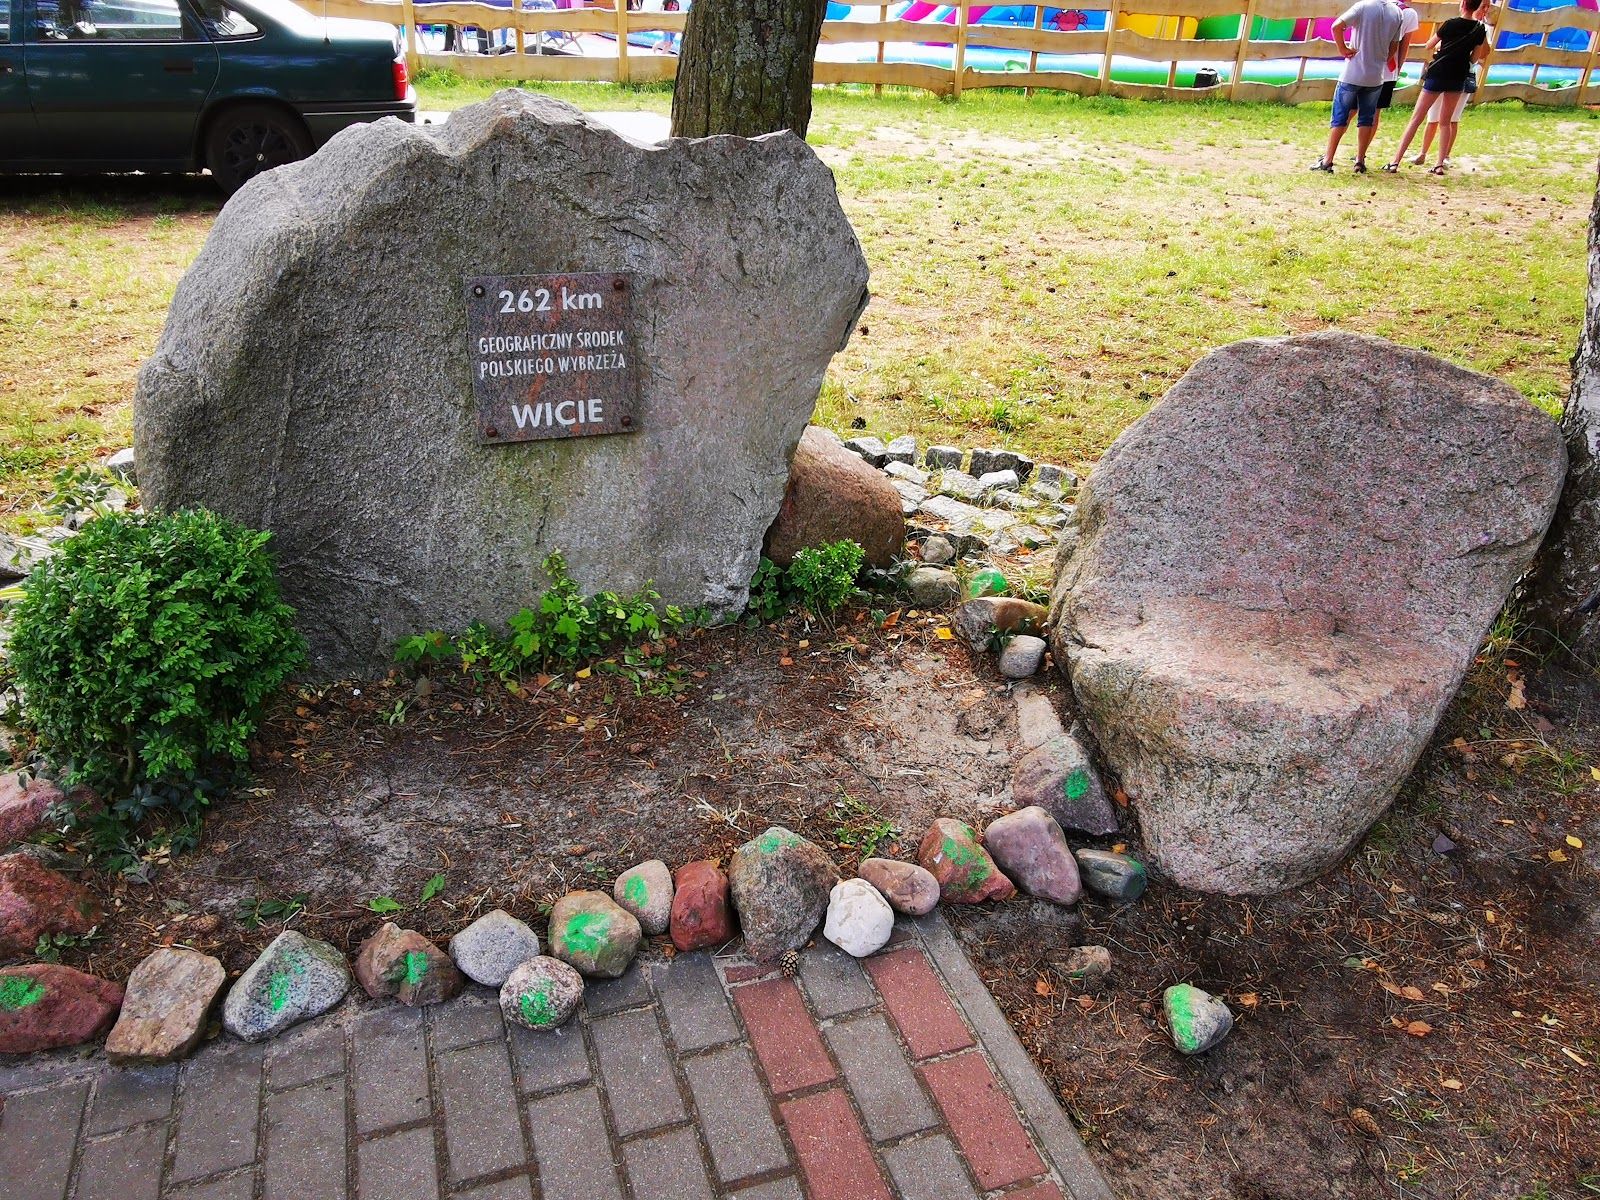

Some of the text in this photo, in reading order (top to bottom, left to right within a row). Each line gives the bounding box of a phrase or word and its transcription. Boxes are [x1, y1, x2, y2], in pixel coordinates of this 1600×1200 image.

[499, 286, 602, 314] 262 km
[478, 328, 624, 355] GEOGRAFICZNY ŚRODEK
[480, 350, 626, 379] POLSKIEGO WYBRZEŻA
[511, 398, 603, 429] WICIE
